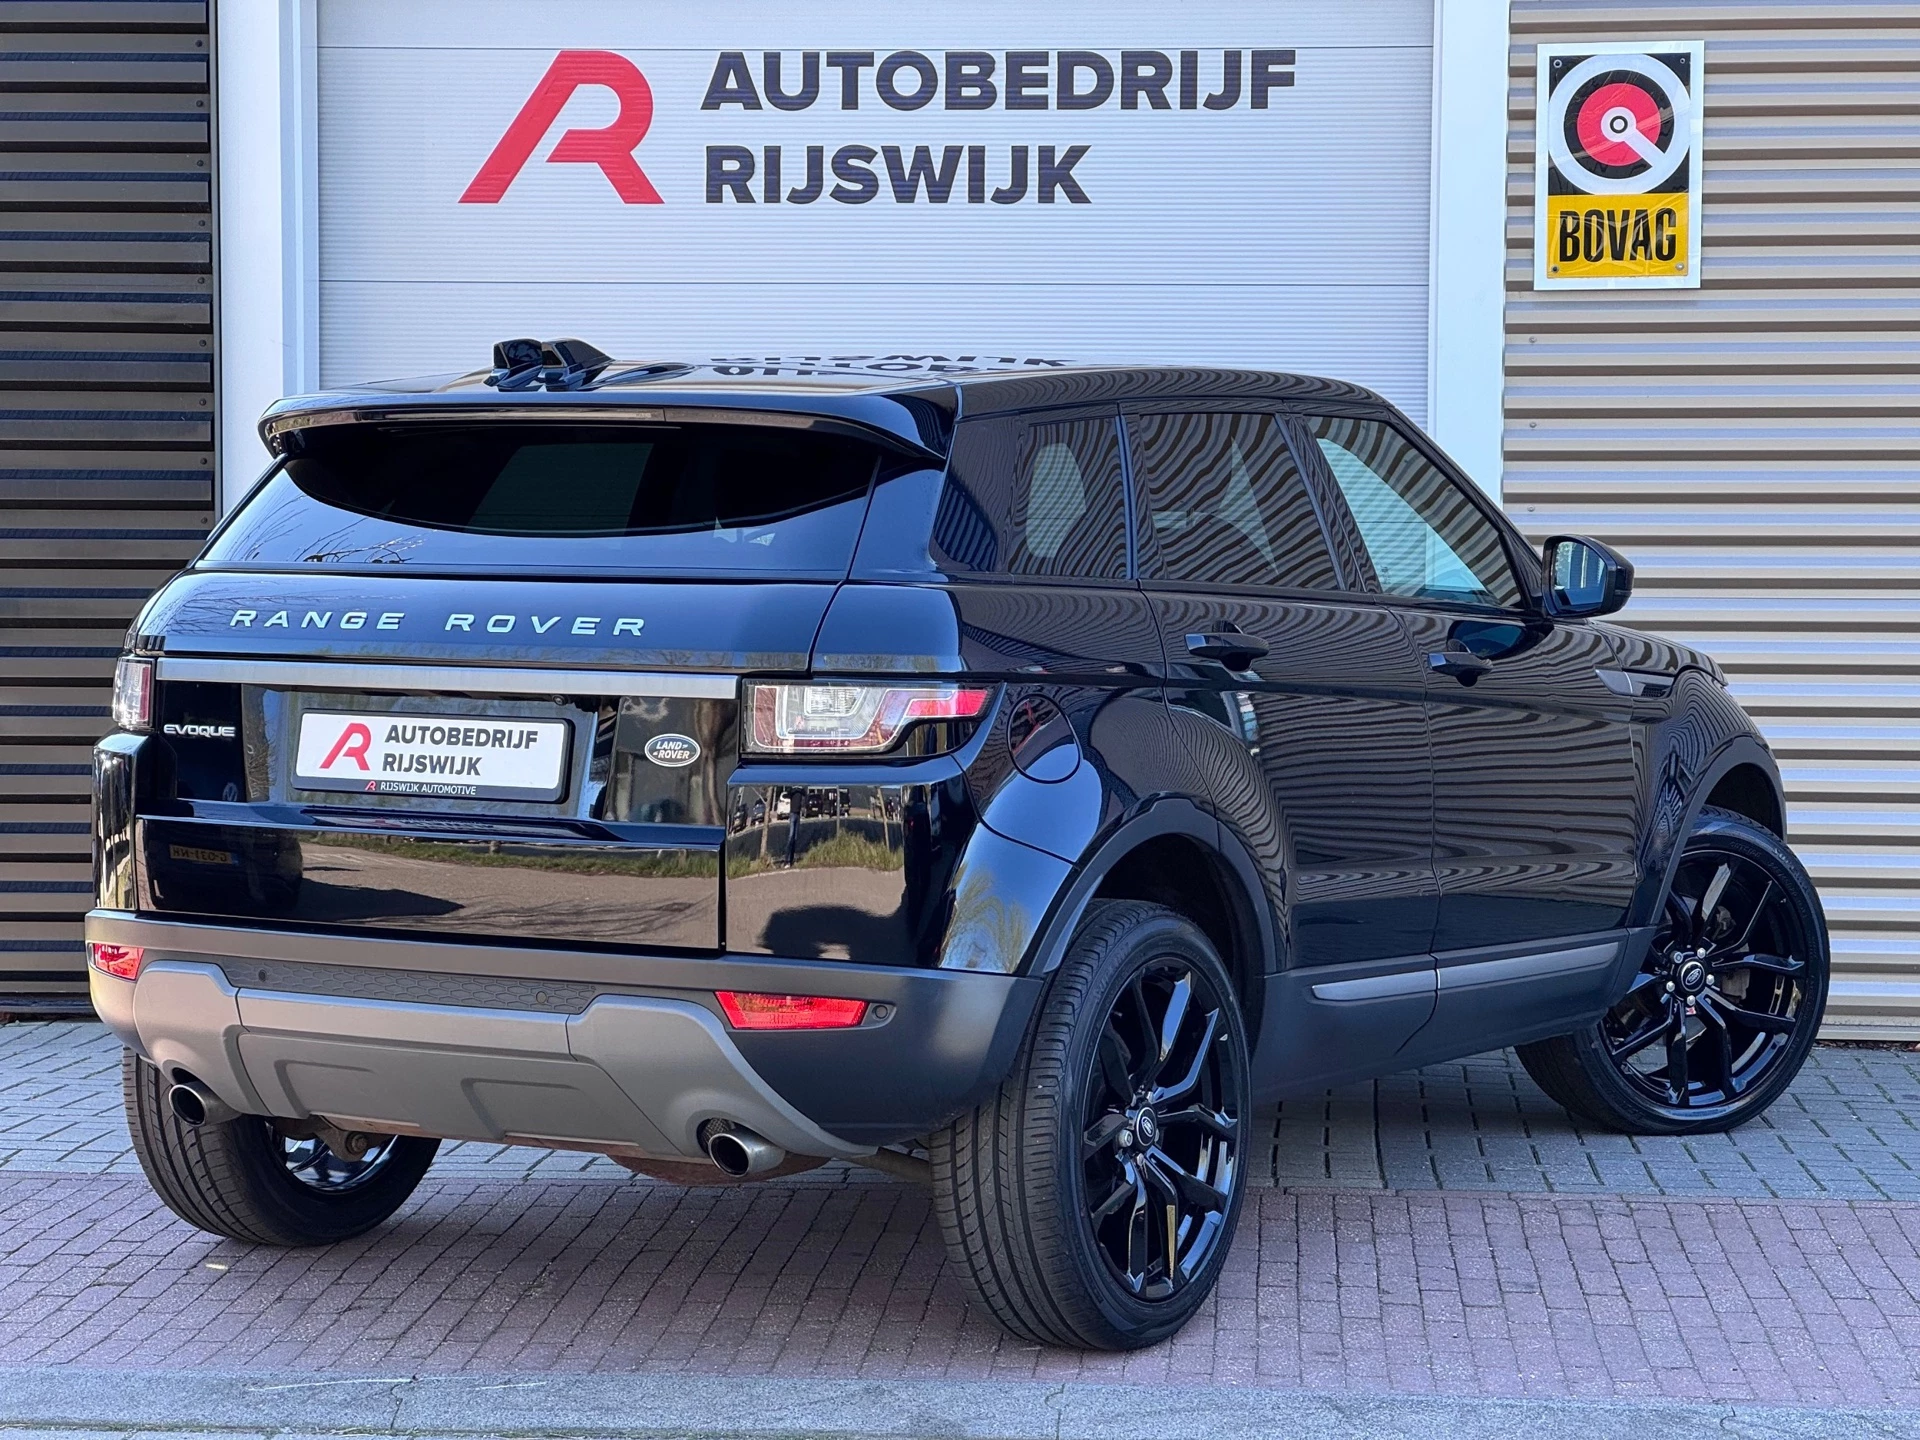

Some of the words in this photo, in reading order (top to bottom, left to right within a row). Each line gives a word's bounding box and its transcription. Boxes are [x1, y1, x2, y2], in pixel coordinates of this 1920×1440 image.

[701, 50, 1296, 111] AUTOBEDRIJF
[706, 145, 1092, 204] RIJSWIJK
[1559, 208, 1677, 262] BOVAG
[230, 610, 404, 630] RANGE
[444, 614, 646, 637] ROVER
[163, 723, 236, 738] EVOQUE
[384, 724, 539, 750] AUTOBEDRIJF
[656, 741, 682, 750] LAND
[657, 750, 690, 759] ROVER
[382, 753, 482, 776] RIJSWIJK
[380, 781, 419, 793] RIJSWIJK
[420, 784, 477, 796] AUTOMOTIVE
